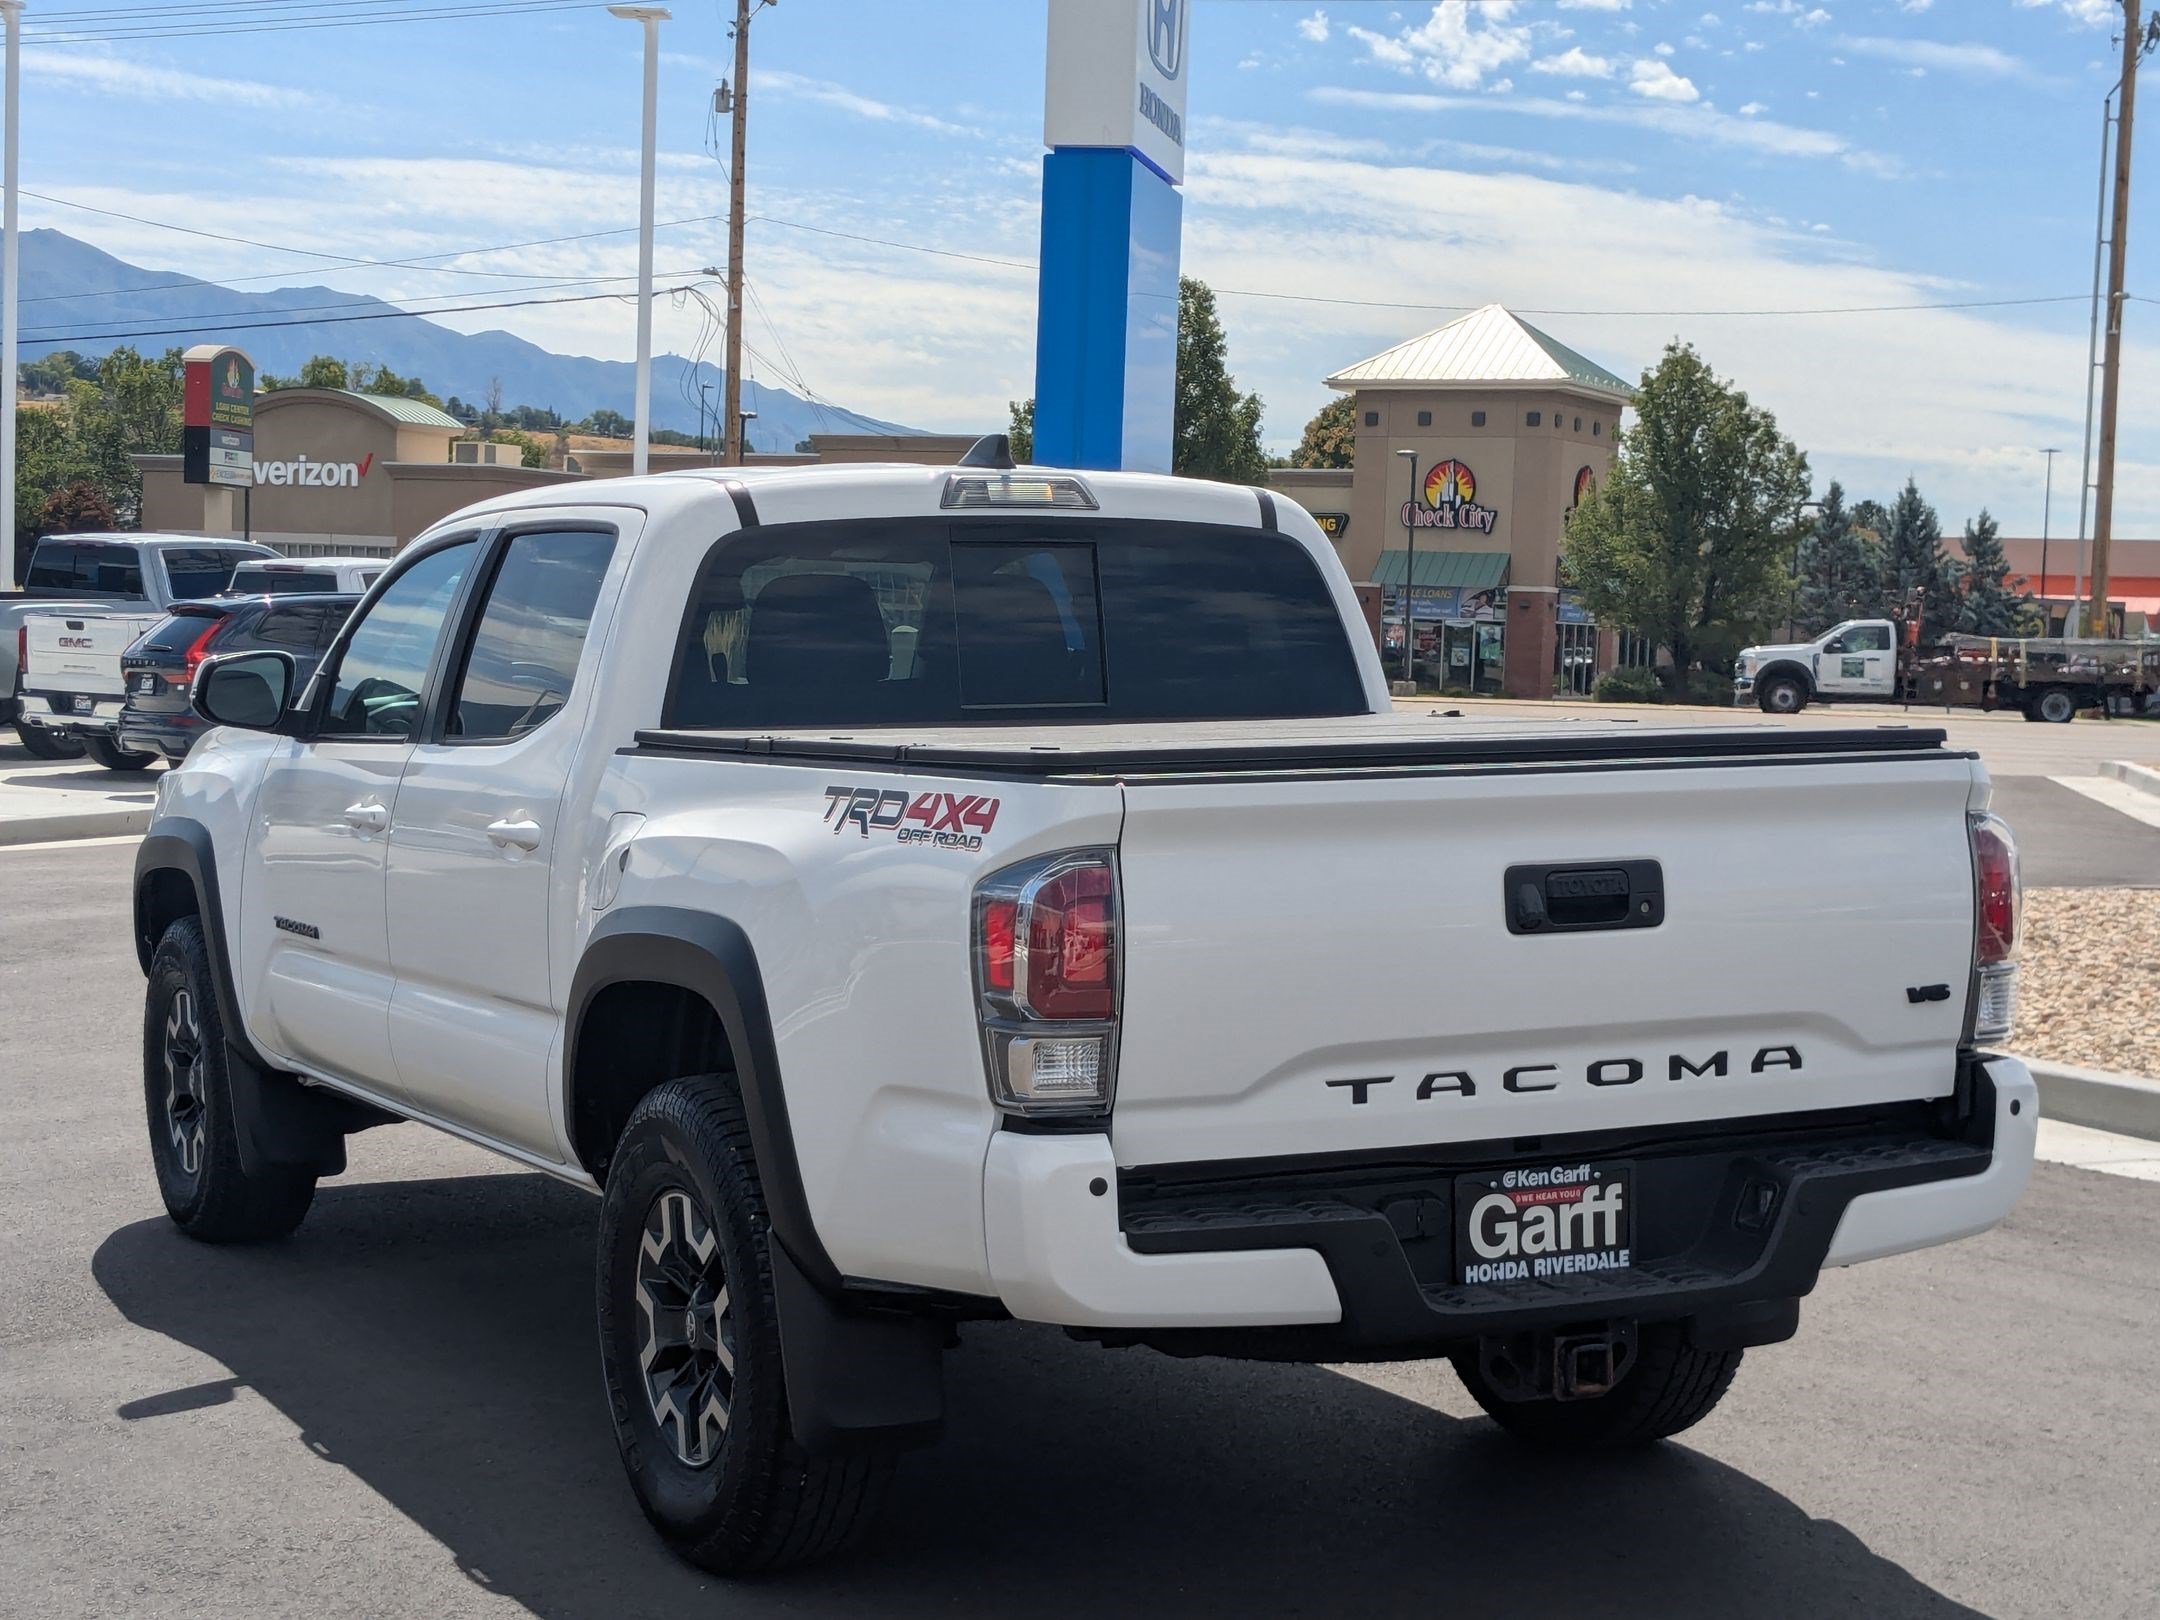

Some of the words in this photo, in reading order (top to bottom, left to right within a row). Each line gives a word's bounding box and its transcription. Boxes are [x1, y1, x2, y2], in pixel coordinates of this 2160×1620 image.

[1139, 82, 1183, 147] HONDA
[252, 454, 359, 487] verizon
[1402, 503, 1455, 528] Check
[1459, 503, 1496, 533] City
[1398, 587, 1422, 598] TILE
[1423, 589, 1453, 600] LOANS
[58, 637, 93, 649] GMC
[824, 785, 910, 839] TRD
[897, 827, 933, 846] OFF
[932, 831, 983, 853] ROAD
[1906, 983, 1951, 1004] V6
[1325, 1044, 1803, 1105] TACOMA
[1517, 1169, 1549, 1187] Ken
[1550, 1164, 1591, 1185] Garff
[1521, 1193, 1534, 1202] WE
[1535, 1191, 1558, 1201] HEAR
[1469, 1182, 1623, 1259] Garff
[1465, 1260, 1529, 1284] HONDA
[1534, 1249, 1630, 1277] RIVERDALE
